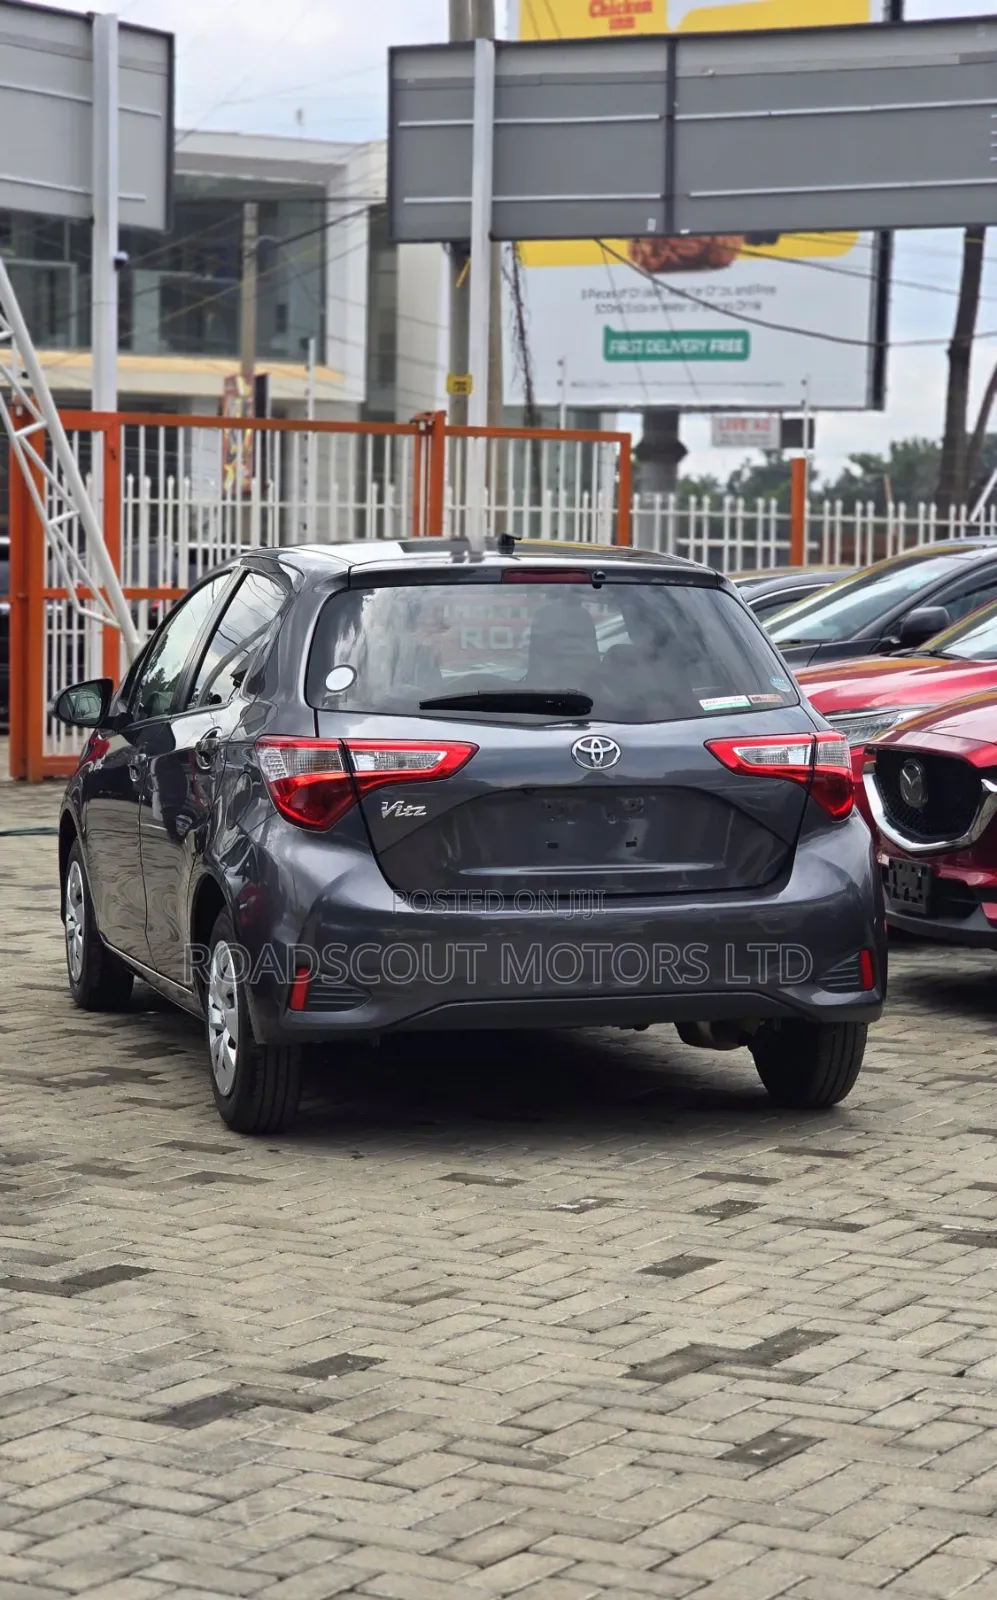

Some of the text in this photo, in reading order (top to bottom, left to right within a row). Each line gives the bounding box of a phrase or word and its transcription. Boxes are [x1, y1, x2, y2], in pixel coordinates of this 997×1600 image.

[608, 338, 744, 354] FIRST DELIVERY FREE
[381, 800, 427, 819] Vitz
